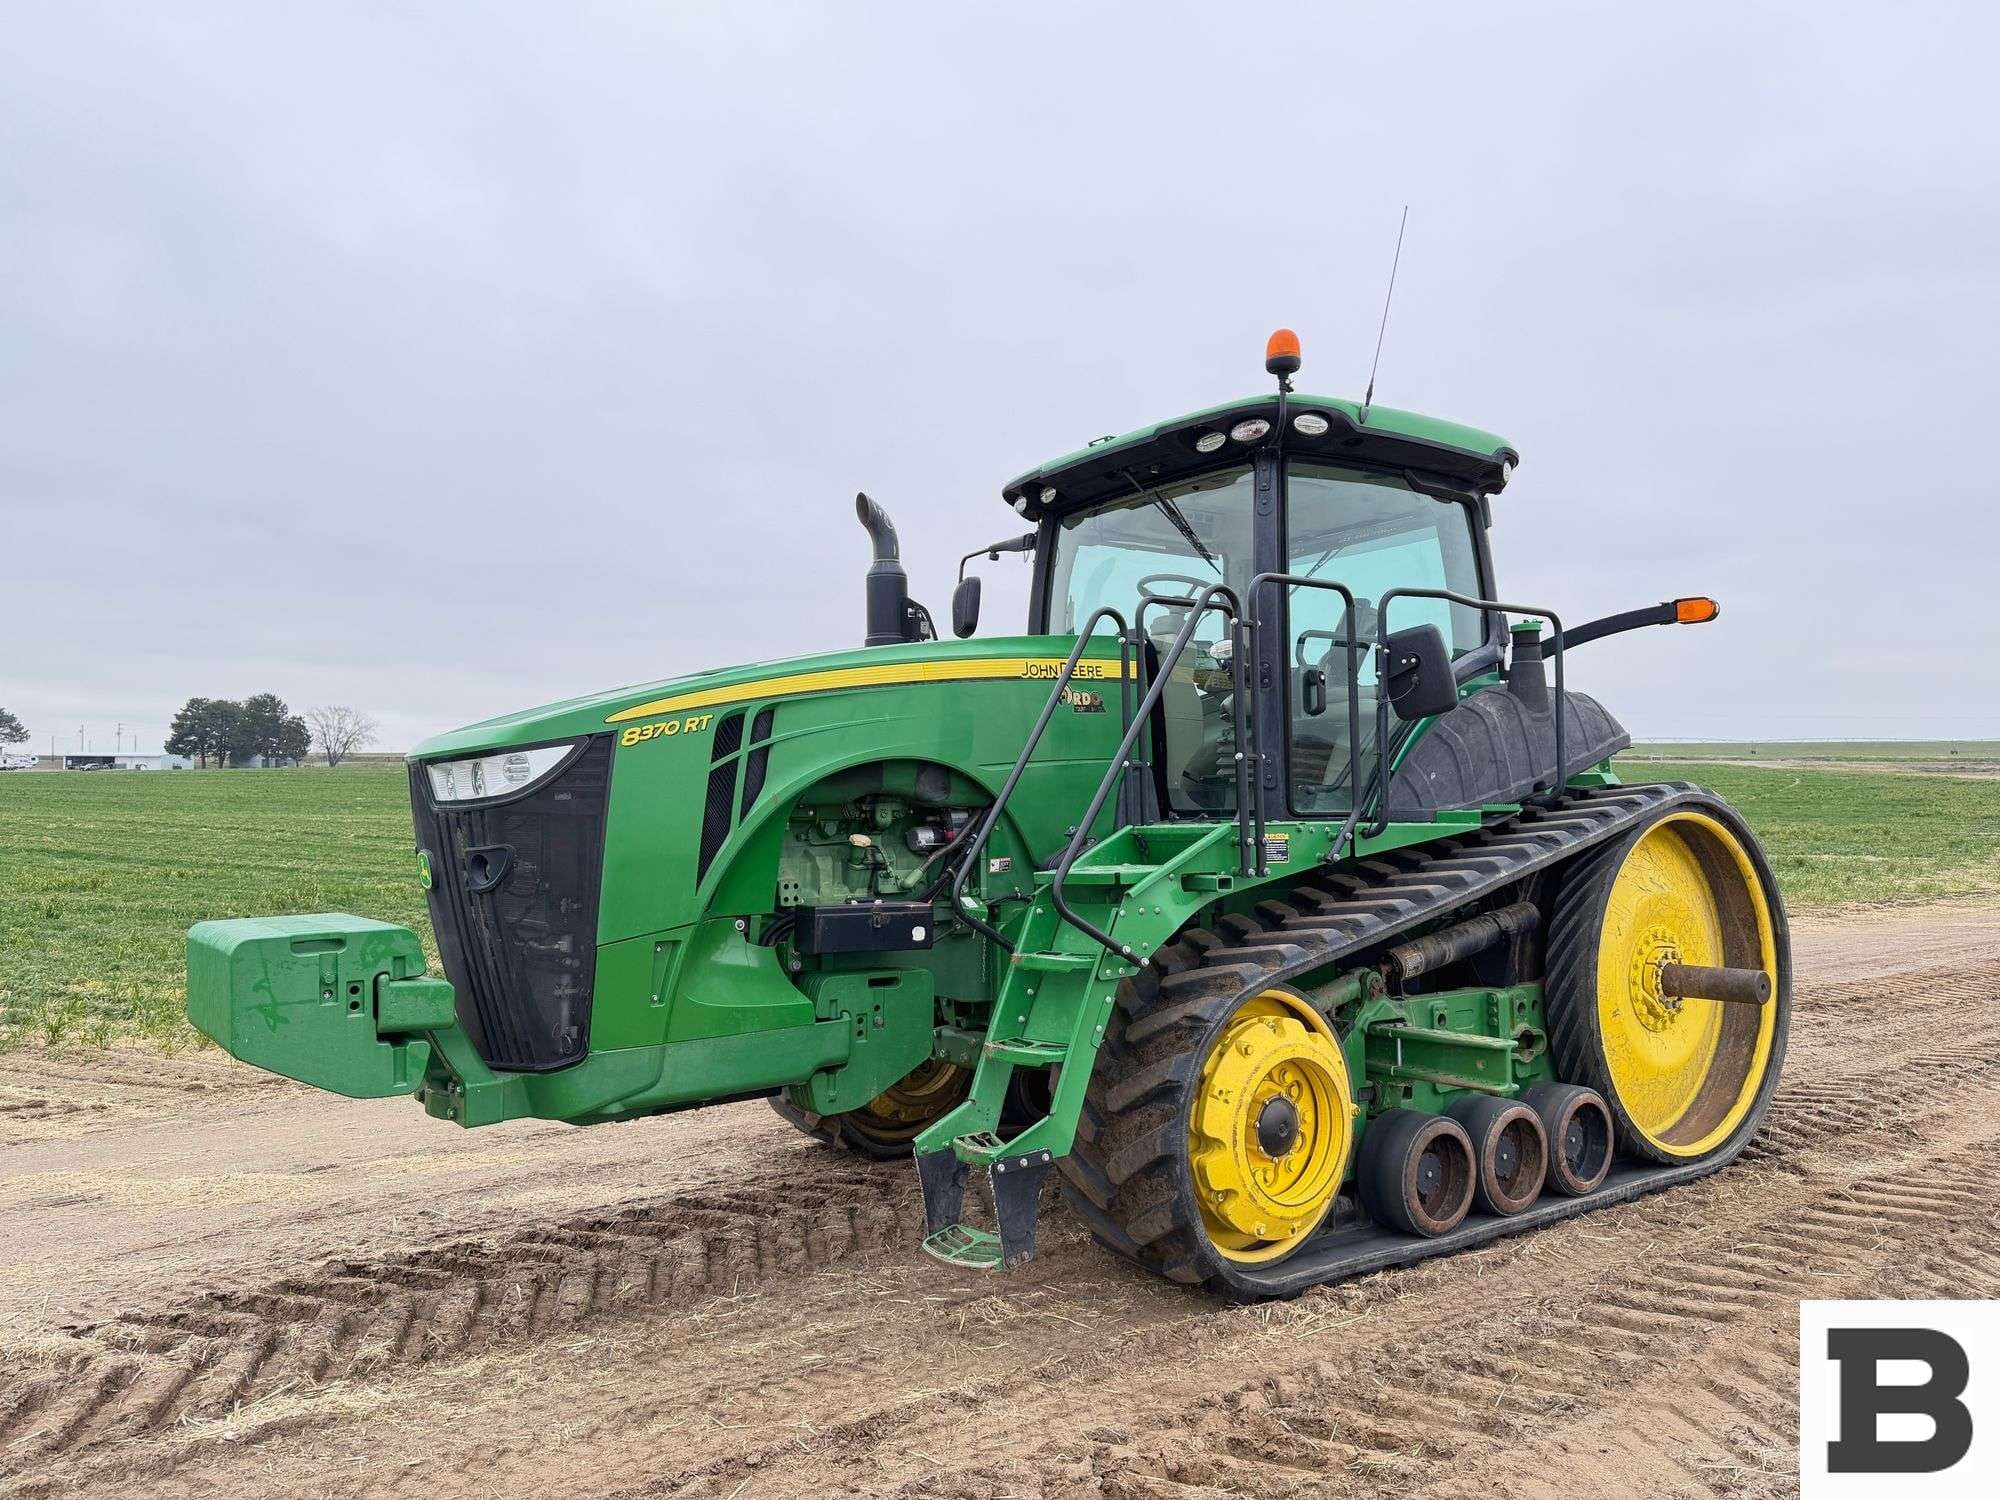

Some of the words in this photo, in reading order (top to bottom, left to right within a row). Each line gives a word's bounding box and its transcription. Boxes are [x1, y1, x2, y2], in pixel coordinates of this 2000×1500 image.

[1021, 661, 1058, 677] JOHN
[621, 720, 681, 747] 8370
[683, 714, 713, 734] RT
